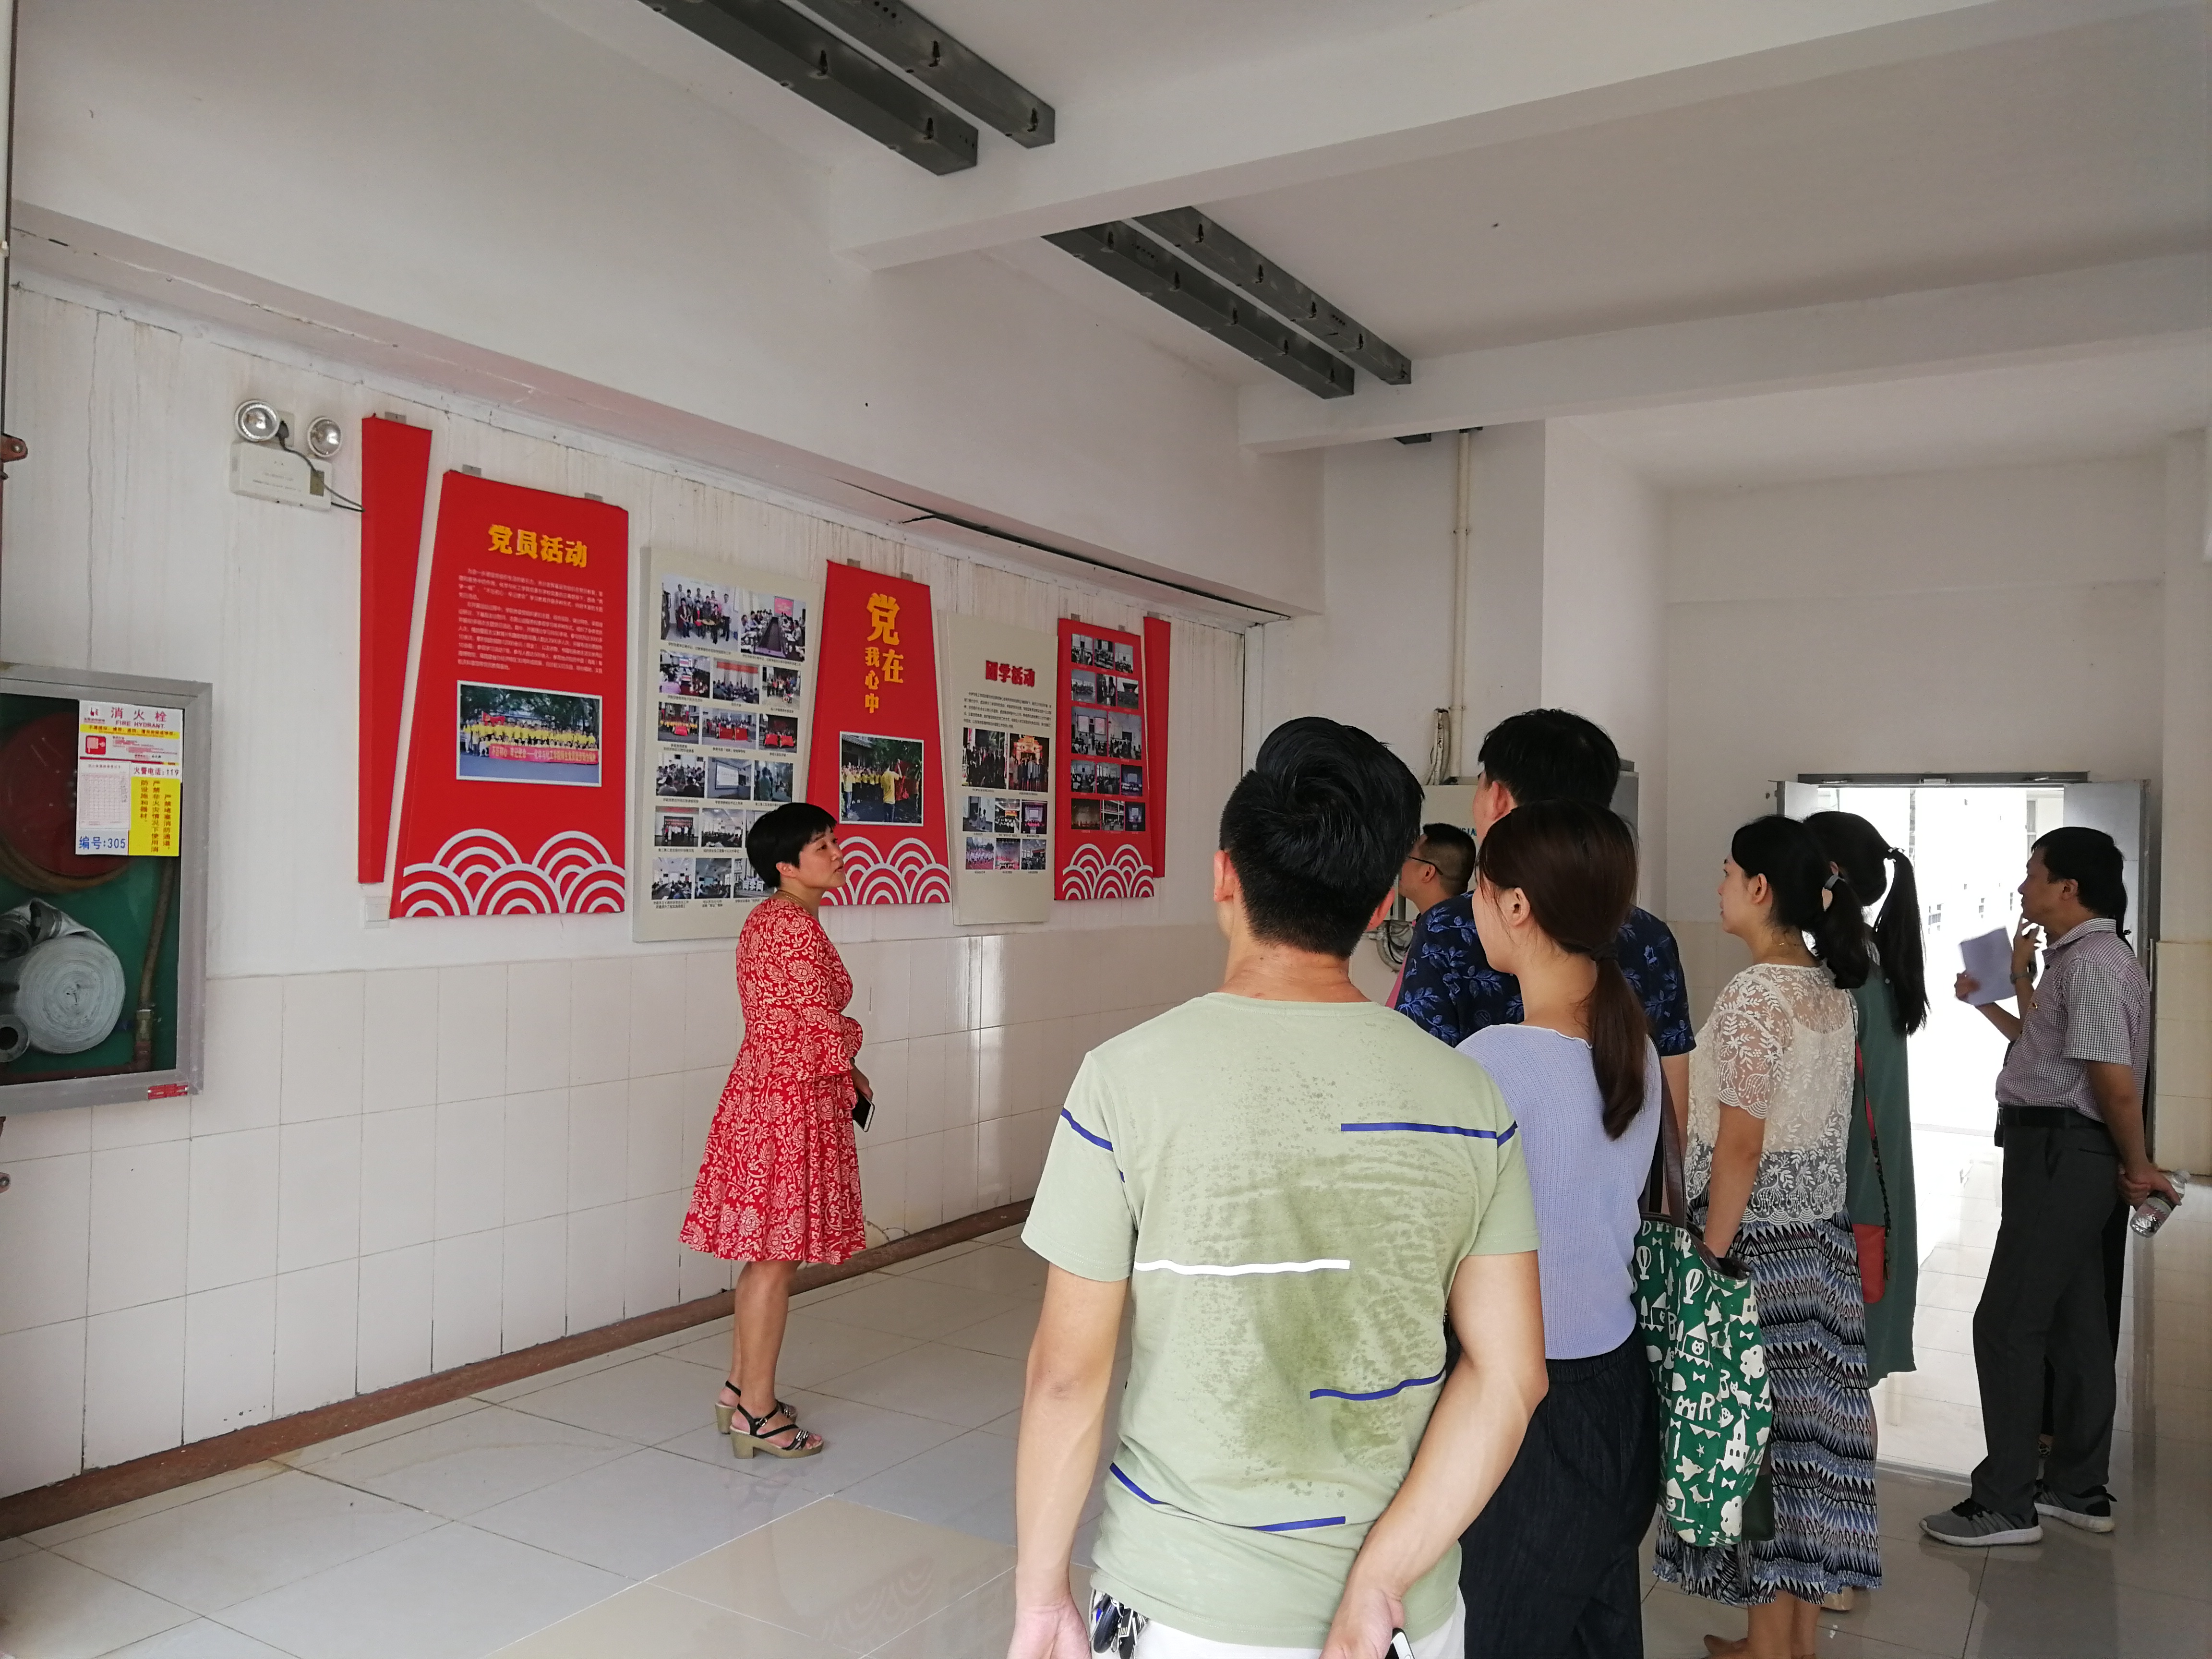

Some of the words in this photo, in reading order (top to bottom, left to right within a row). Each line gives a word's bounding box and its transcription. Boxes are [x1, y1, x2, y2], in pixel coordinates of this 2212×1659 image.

[488, 524, 588, 568] 党员活动
[111, 706, 167, 722] 消火栓
